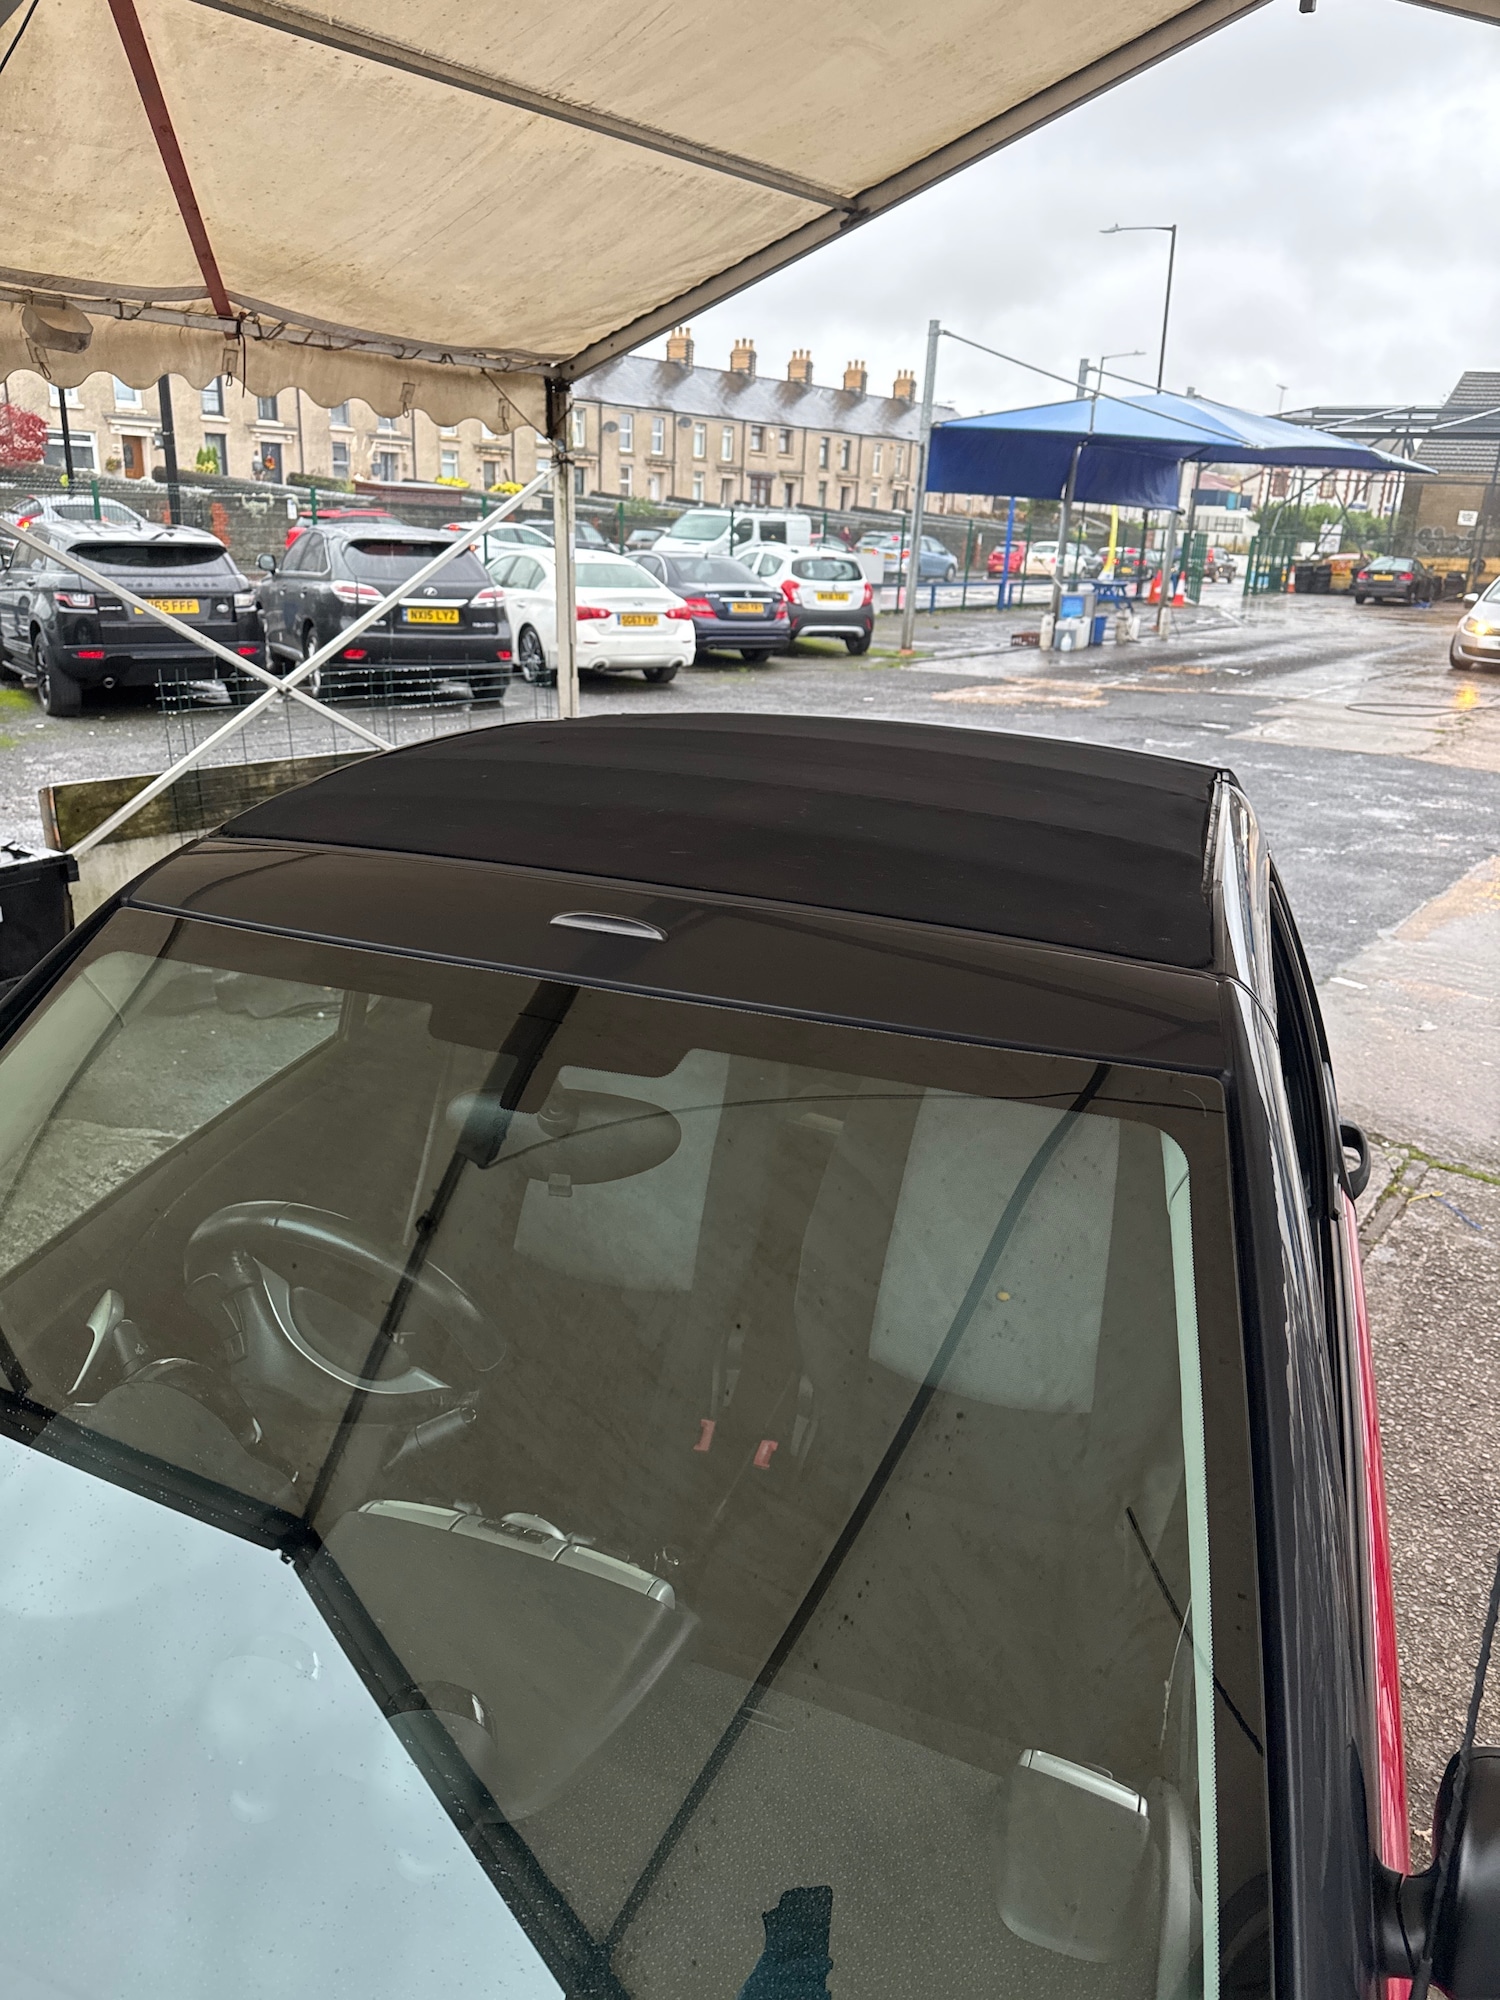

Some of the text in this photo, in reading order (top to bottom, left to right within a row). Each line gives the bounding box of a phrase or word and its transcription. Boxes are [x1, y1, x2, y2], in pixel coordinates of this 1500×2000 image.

[172, 600, 193, 611] FFF
[411, 610, 456, 621] NX15 LYZ
